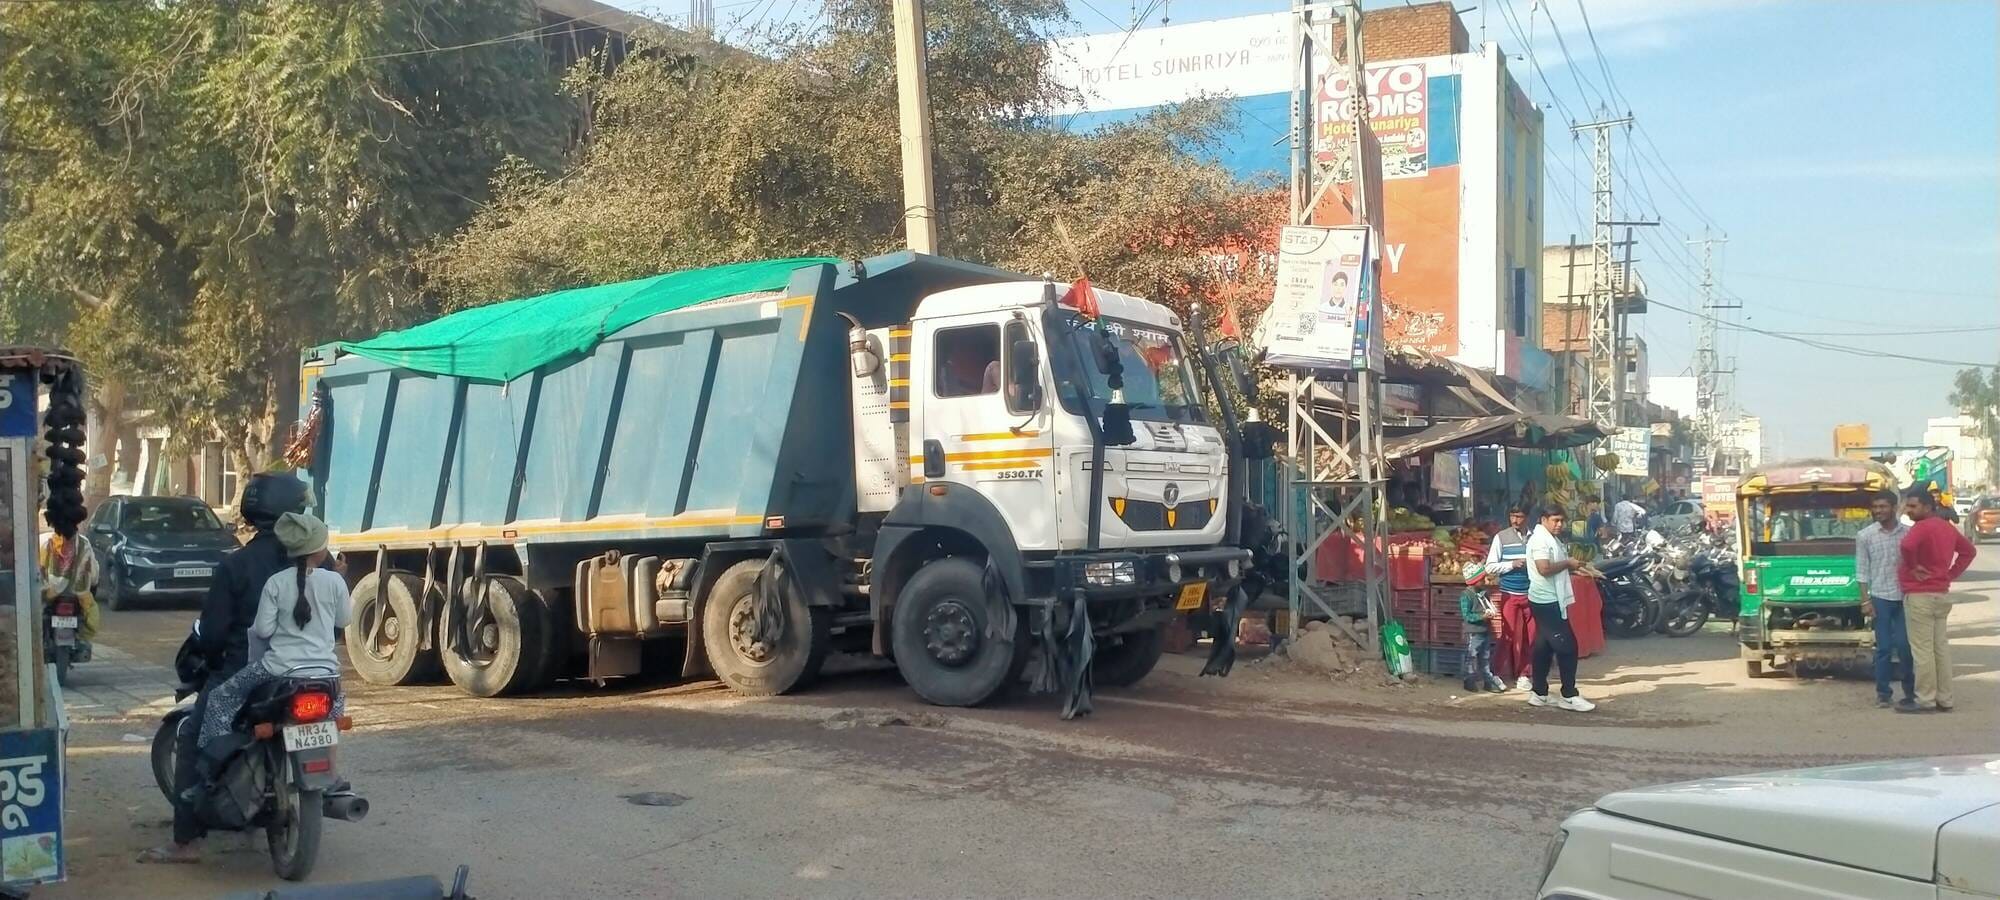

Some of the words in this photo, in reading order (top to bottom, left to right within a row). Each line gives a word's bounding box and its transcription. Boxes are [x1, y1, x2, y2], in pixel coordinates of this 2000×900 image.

[1081, 63, 1143, 85] HOTEL
[1151, 49, 1250, 76] SUNARIYA
[1324, 64, 1423, 99] OYO
[1323, 121, 1351, 136] Hote
[1369, 117, 1420, 132] unariya
[1131, 328, 1169, 343] श्याम
[997, 469, 1044, 480] 3530.TK
[297, 723, 329, 737] HR34
[294, 734, 333, 749] N4380
